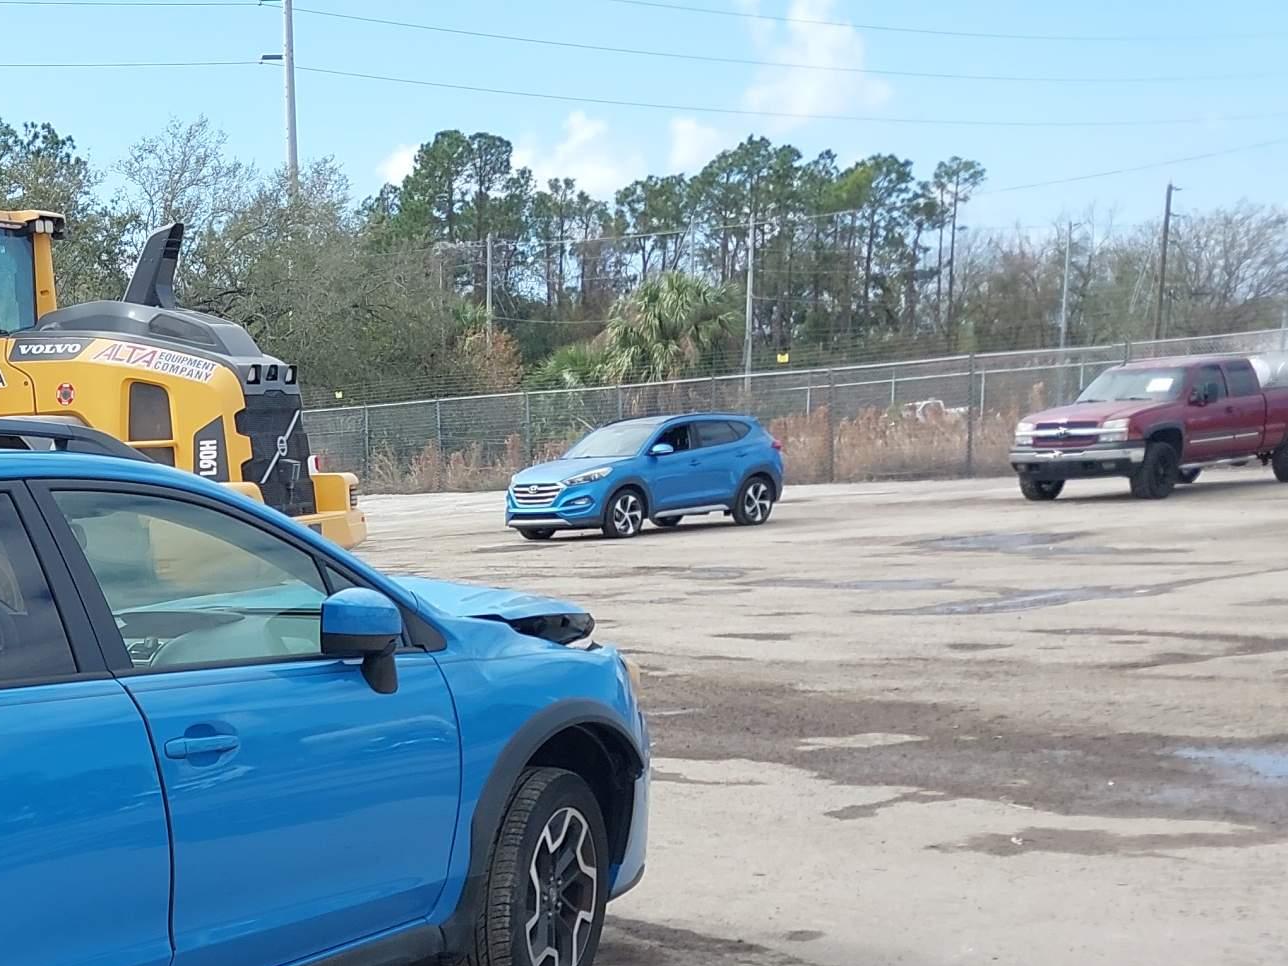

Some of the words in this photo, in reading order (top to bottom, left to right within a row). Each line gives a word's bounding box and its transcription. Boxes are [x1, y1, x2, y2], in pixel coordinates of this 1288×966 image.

[18, 343, 82, 355] VOLVO
[93, 343, 156, 368] ALTA
[153, 361, 213, 382] COMPANY
[158, 351, 217, 373] EQUIPMENT
[199, 439, 217, 476] L90H
